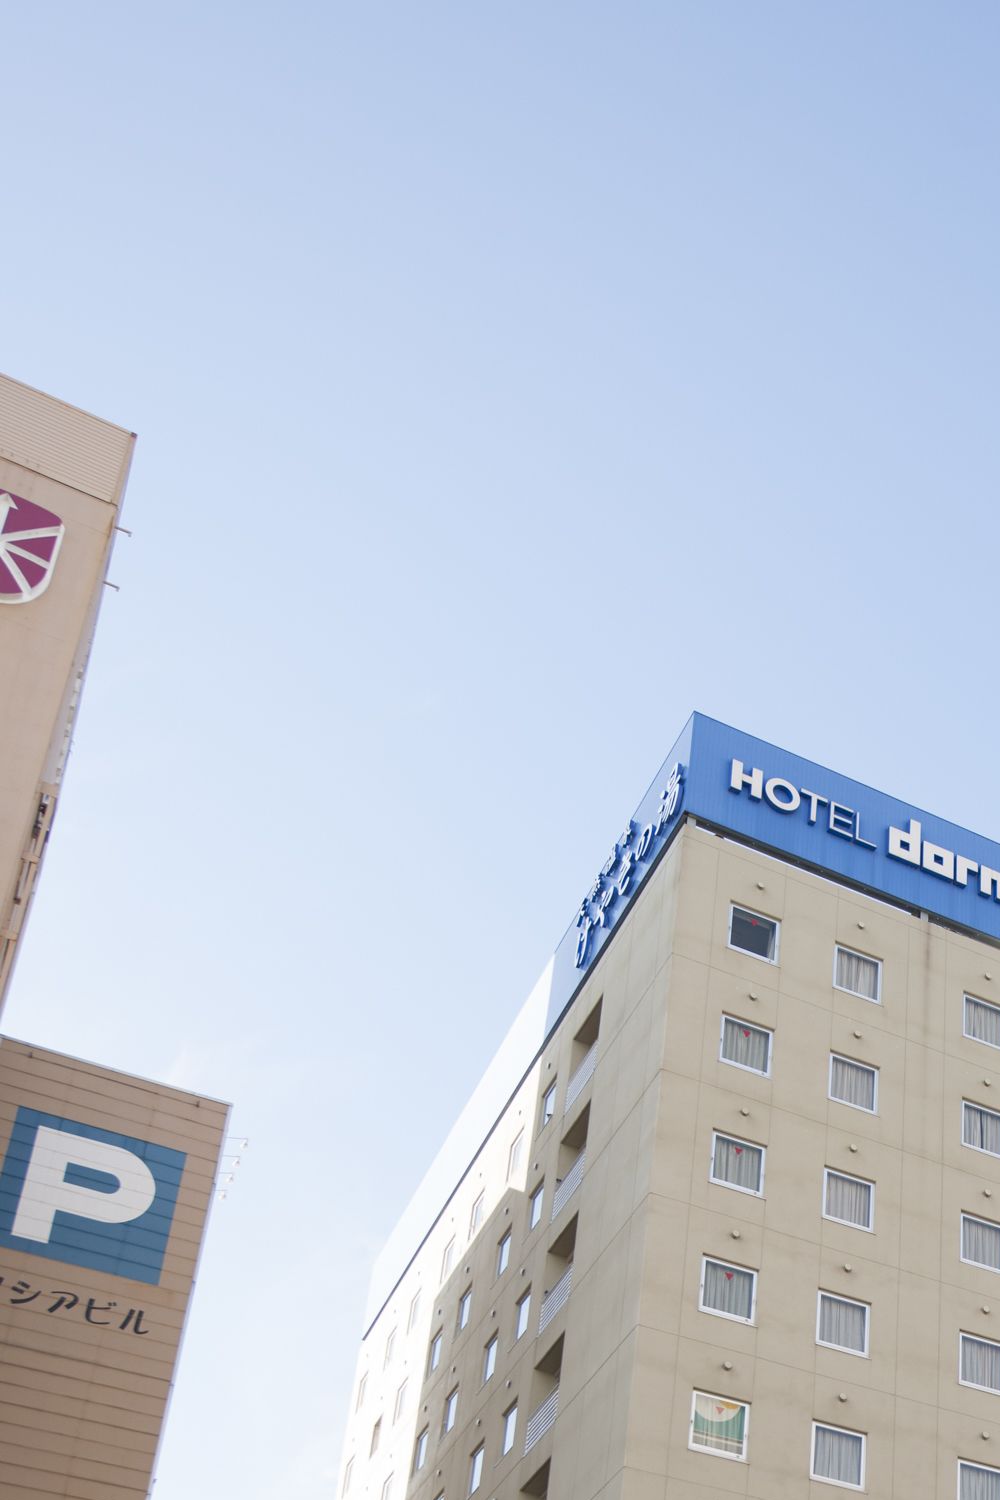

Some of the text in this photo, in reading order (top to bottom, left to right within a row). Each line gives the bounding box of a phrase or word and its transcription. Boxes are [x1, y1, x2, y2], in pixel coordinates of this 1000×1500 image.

[730, 758, 877, 849] HOTEL
[10, 1125, 156, 1244] P
[0, 1277, 149, 1335] シアビル
